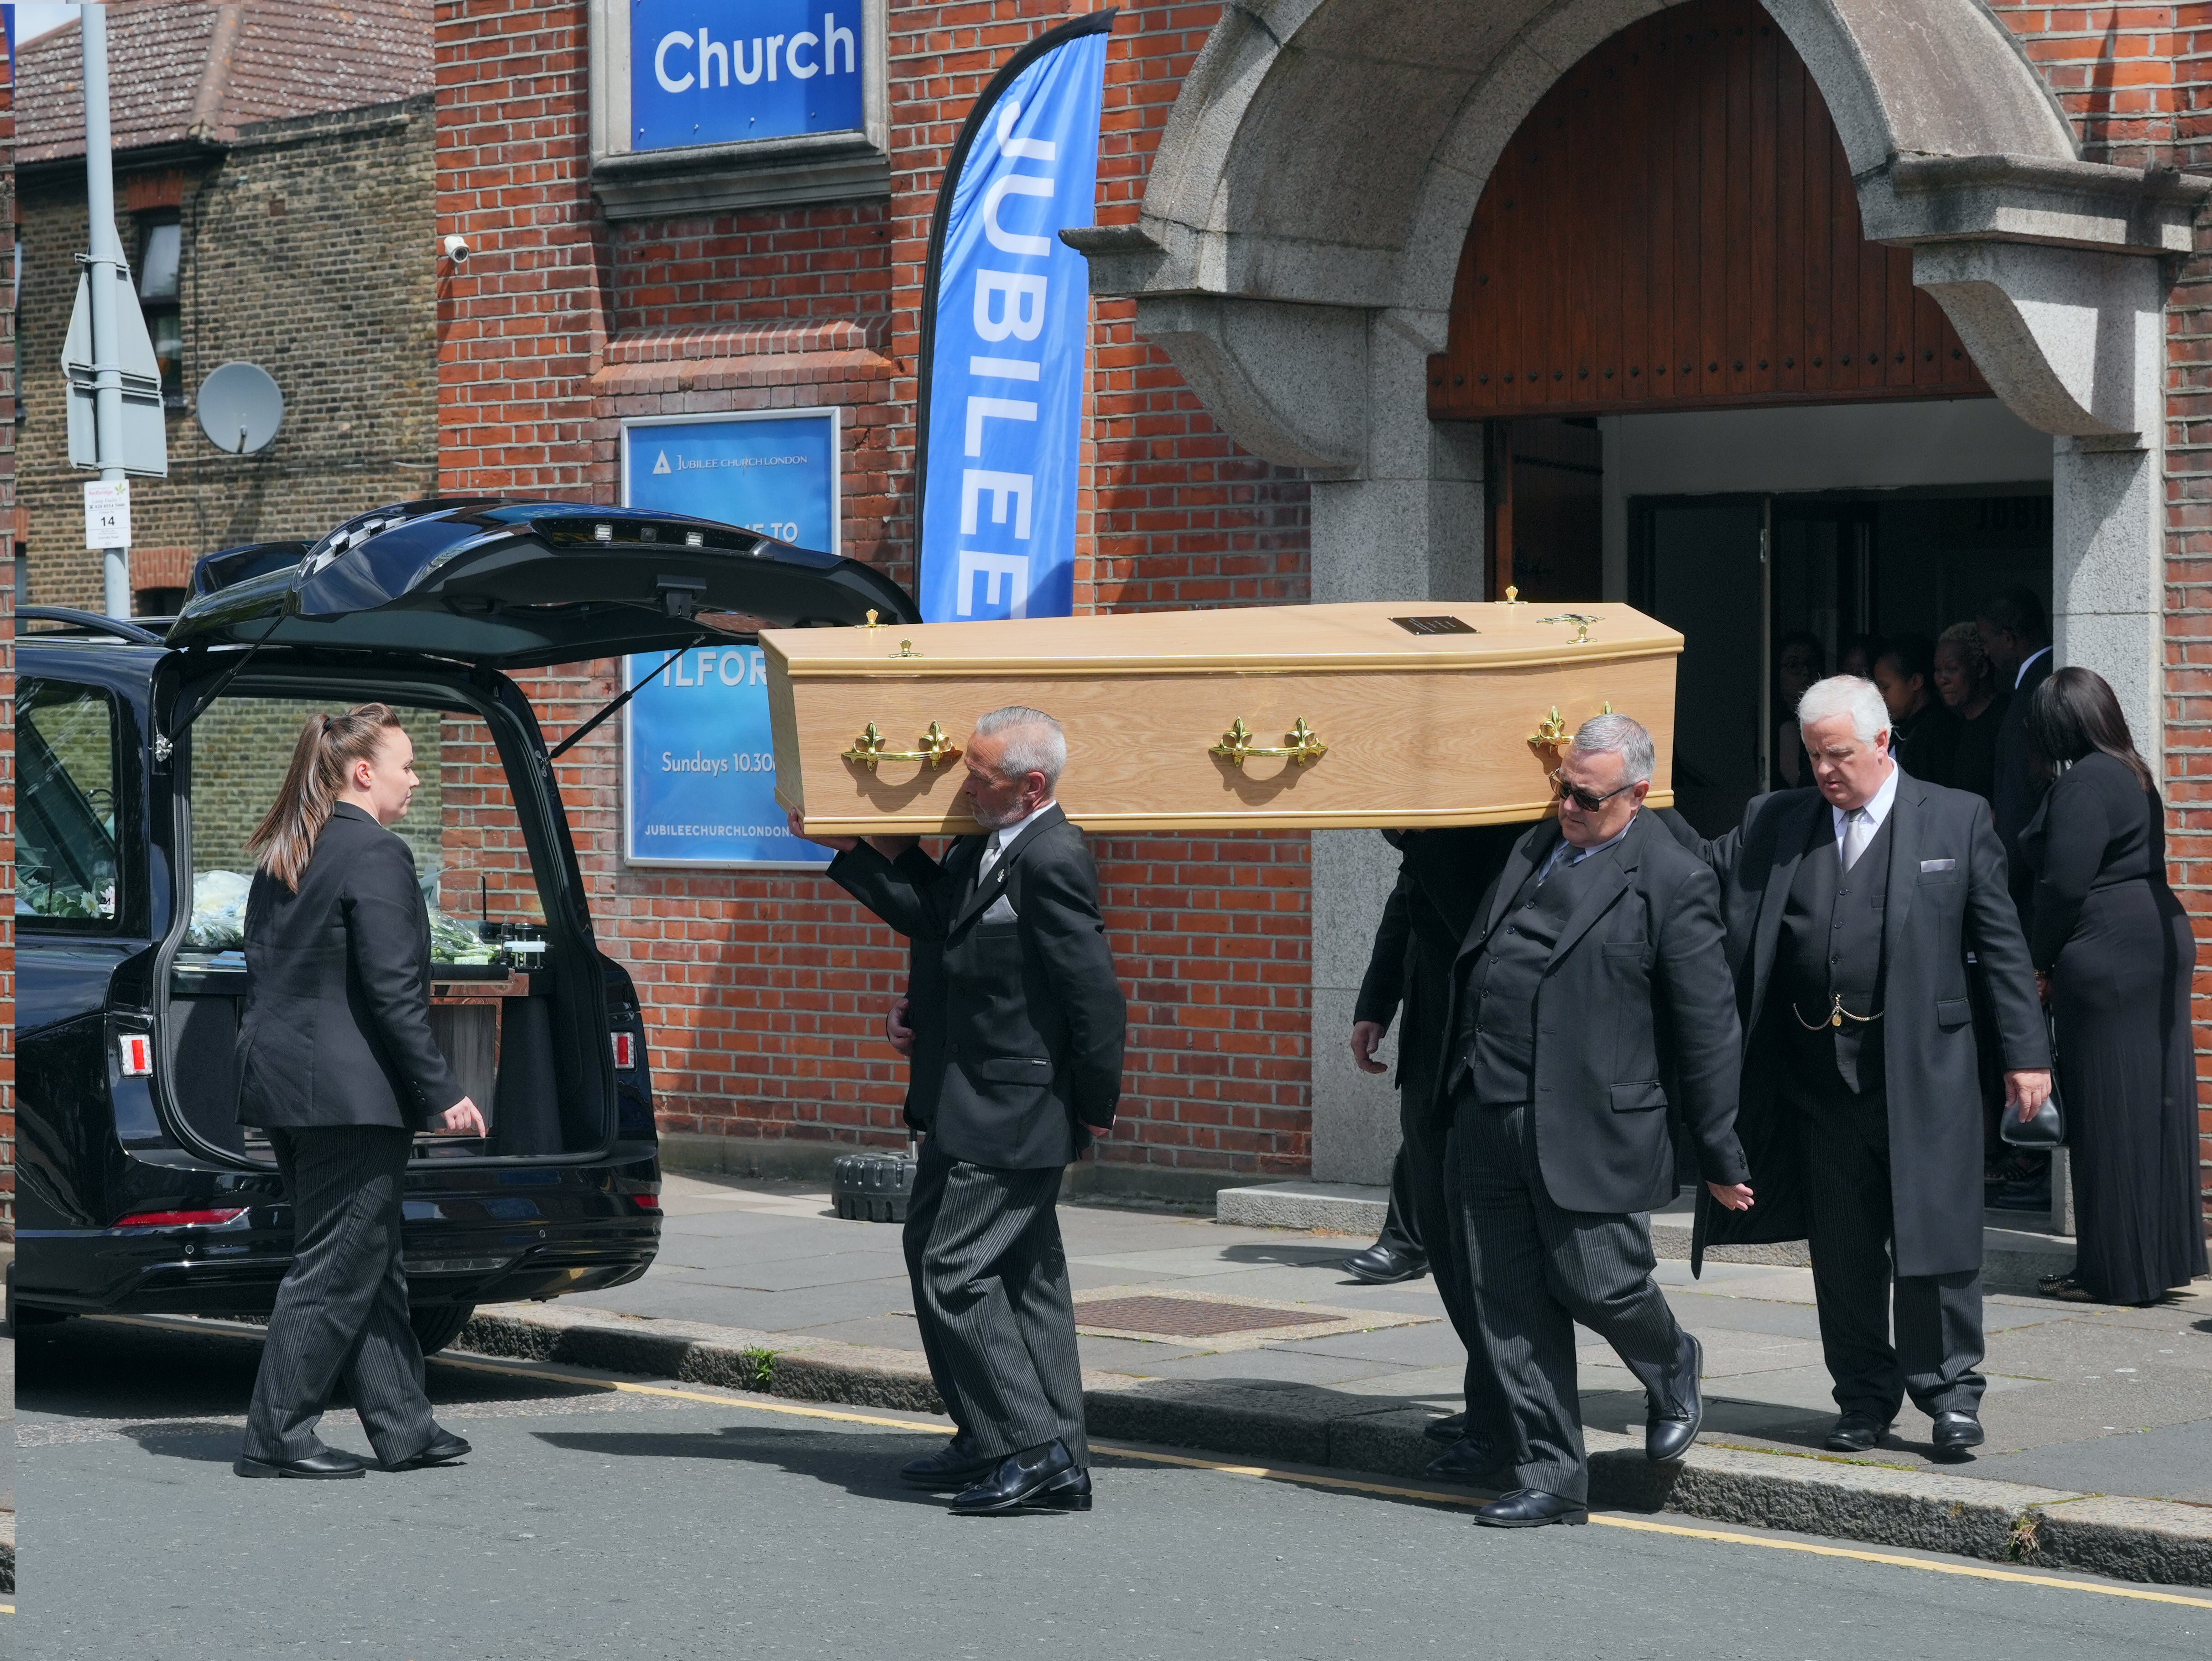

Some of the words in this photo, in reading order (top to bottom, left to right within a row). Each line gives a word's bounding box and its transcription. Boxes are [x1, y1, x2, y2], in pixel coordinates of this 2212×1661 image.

[654, 12, 855, 93] Church
[957, 100, 1055, 619] JUBILEE
[676, 455, 718, 470] JUBILEE
[721, 457, 762, 467] CHURCH
[764, 456, 807, 466] LONDON
[101, 516, 115, 526] 14
[1977, 496, 2052, 530] JUBI
[771, 522, 798, 543] TO
[662, 750, 728, 777] Sundays
[733, 752, 776, 772] 10.30
